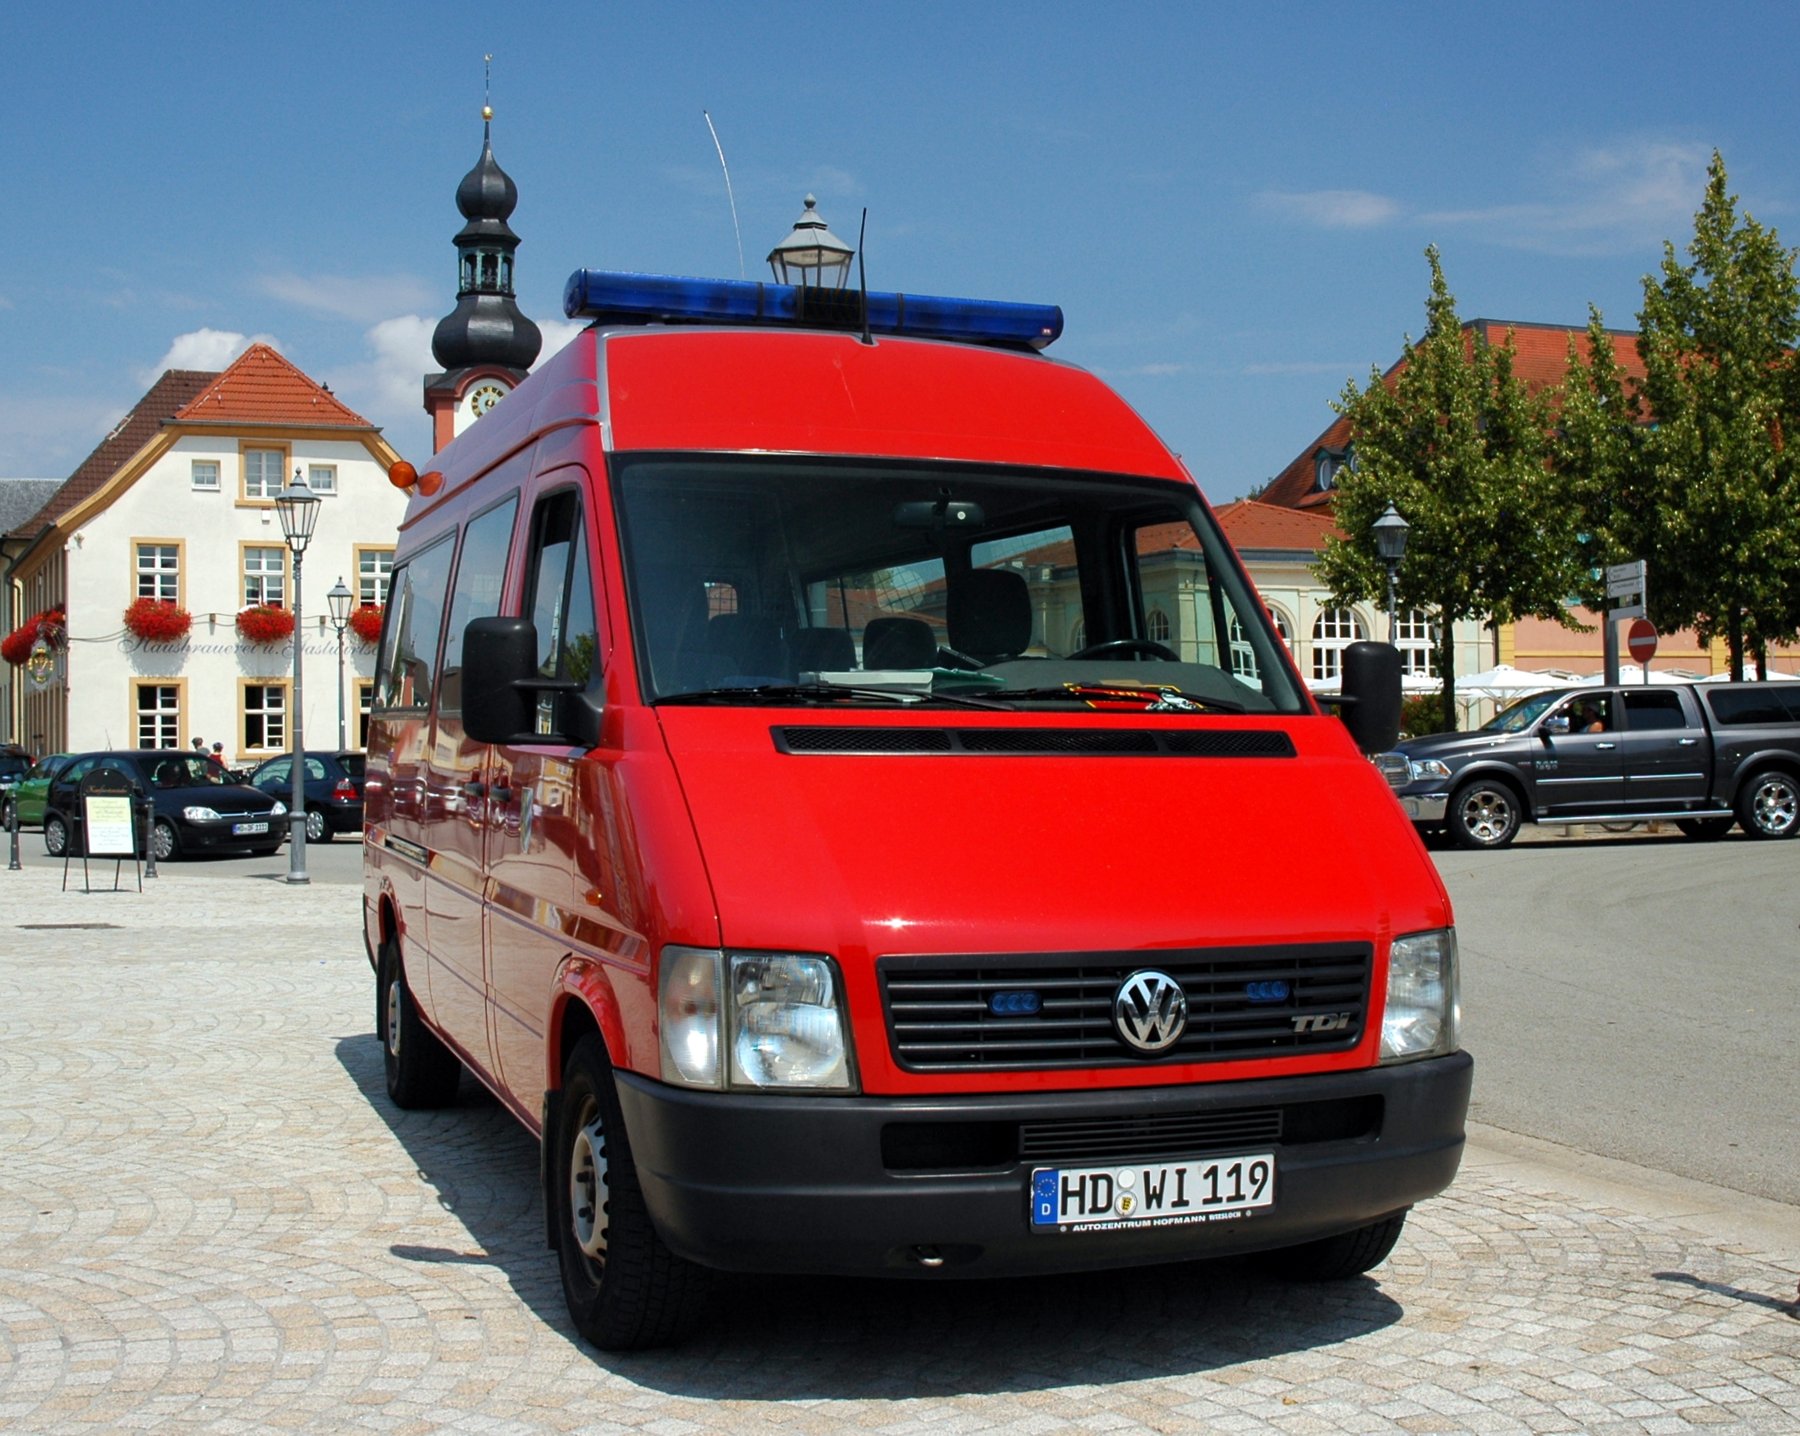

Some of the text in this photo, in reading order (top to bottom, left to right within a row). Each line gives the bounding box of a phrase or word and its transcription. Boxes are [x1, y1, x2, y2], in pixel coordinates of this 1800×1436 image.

[1060, 1160, 1269, 1216] HD WI 119
[1041, 1203, 1050, 1216] D
[1072, 1219, 1152, 1232] AUTOZENTRUM
[1153, 1215, 1206, 1226] HOFMANN
